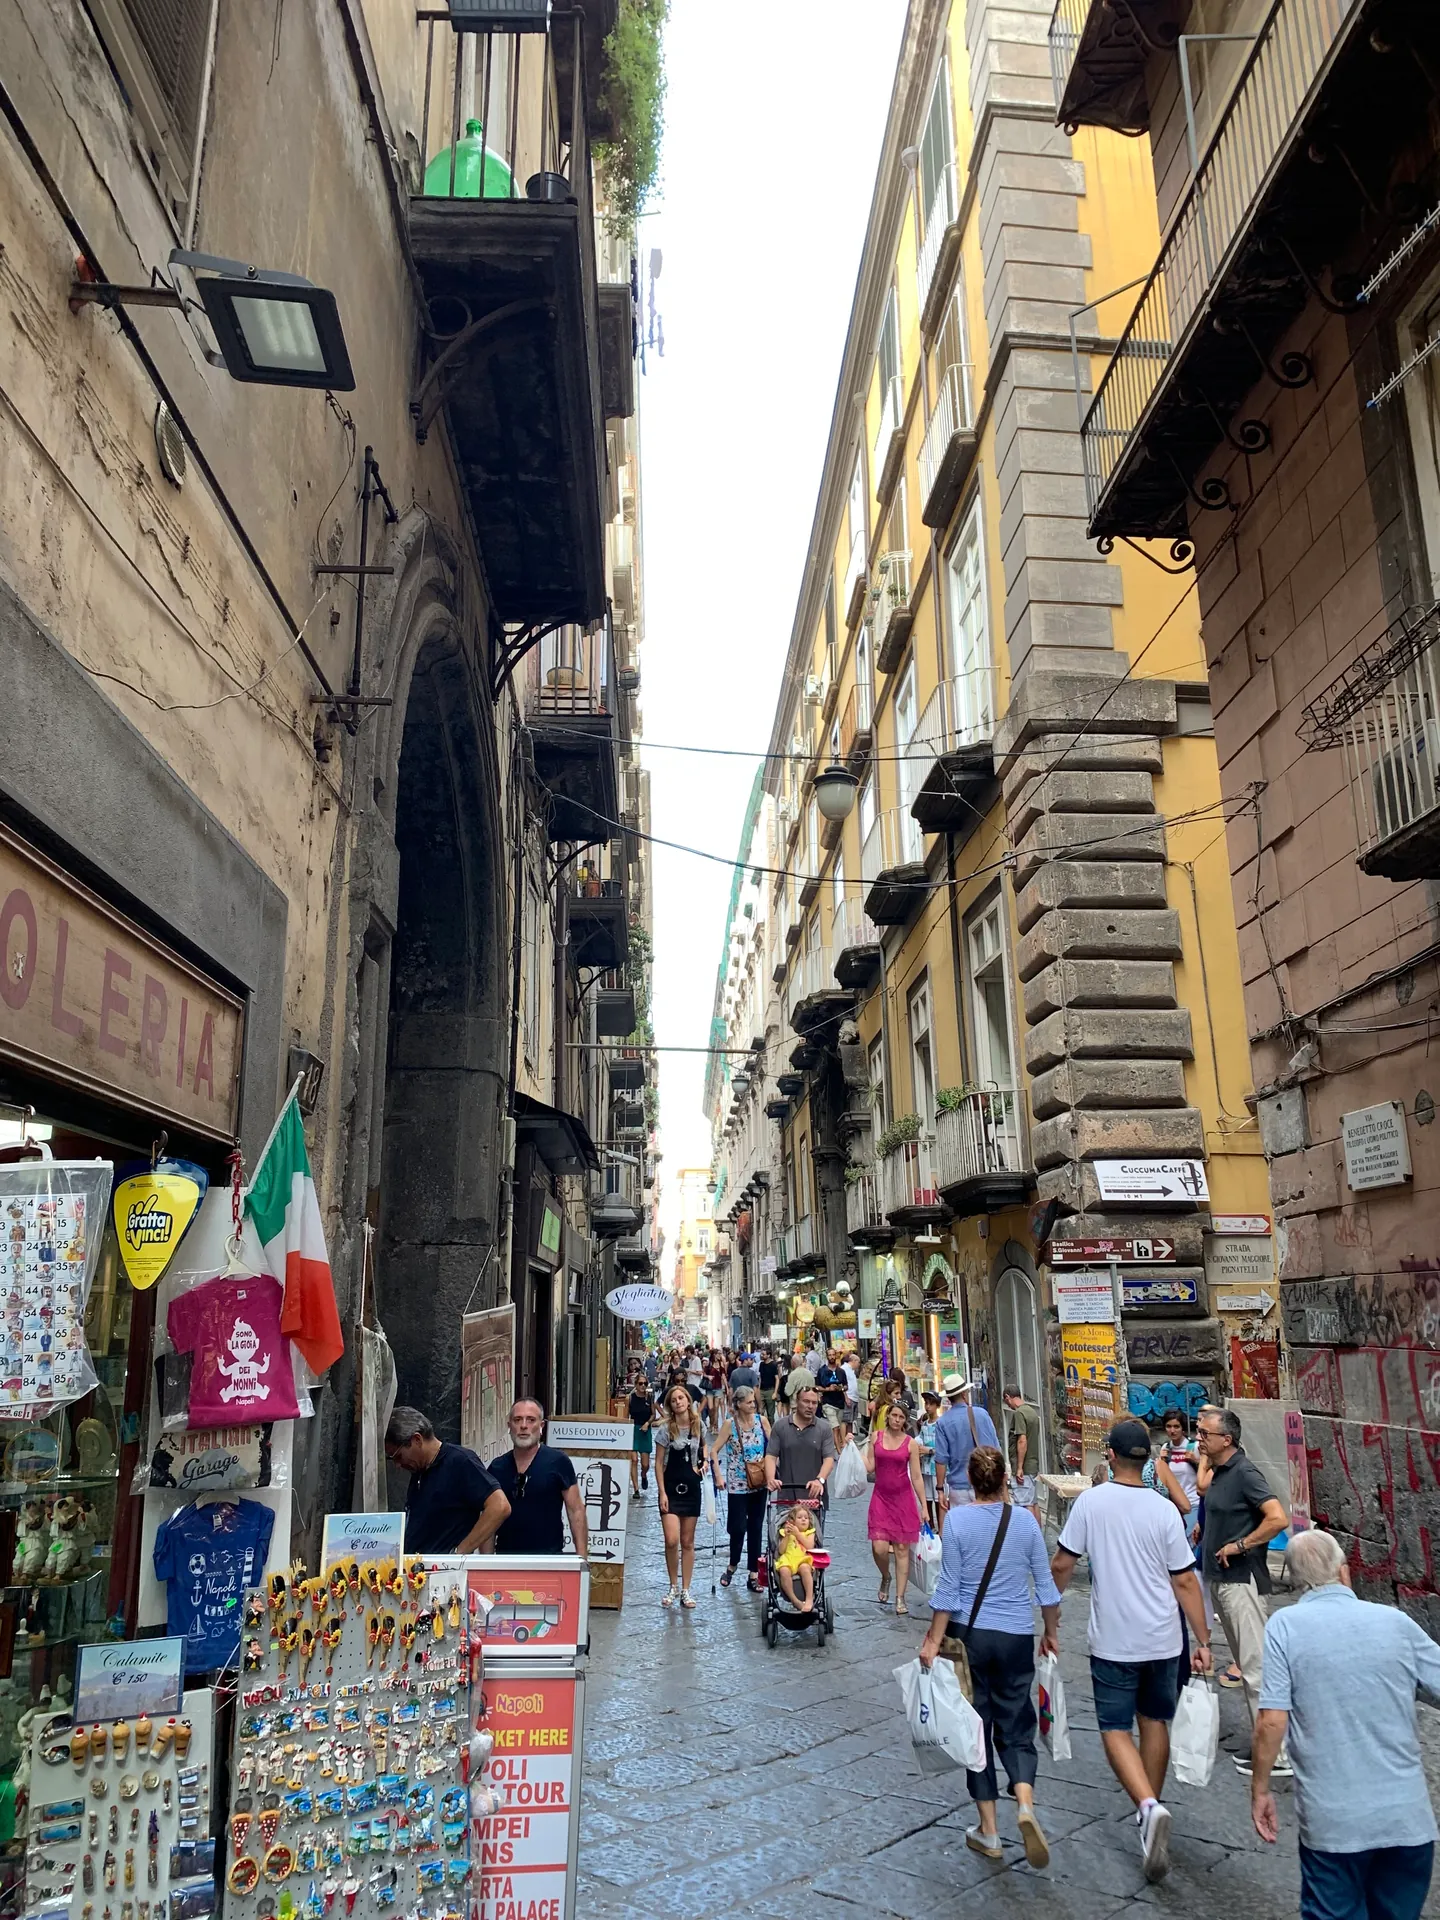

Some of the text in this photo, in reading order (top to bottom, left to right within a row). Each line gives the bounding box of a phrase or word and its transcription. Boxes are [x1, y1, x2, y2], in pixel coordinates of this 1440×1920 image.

[1364, 1114, 1373, 1122] VIA
[1347, 1118, 1394, 1139] BENEDETTO CROCE
[27, 1220, 37, 1229] 14
[57, 1219, 67, 1228] 15
[128, 1212, 167, 1229] Gratta
[26, 1243, 39, 1251] 24
[56, 1240, 69, 1249] 25
[1225, 1244, 1251, 1253] STRADA
[1241, 1254, 1271, 1263] MAGGIORE
[25, 1264, 38, 1273] 34
[55, 1262, 68, 1271] 35
[1221, 1265, 1259, 1274] PIGNATELLI
[25, 1286, 38, 1295] 44
[56, 1284, 69, 1293] 45
[23, 1308, 37, 1317] 54
[54, 1306, 67, 1315] 55
[23, 1331, 37, 1340] 64
[55, 1328, 67, 1338] 65
[235, 1330, 252, 1338] SONO
[231, 1340, 239, 1350] LA
[23, 1354, 34, 1363] 74
[54, 1351, 66, 1361] 75
[22, 1377, 36, 1387] 84
[54, 1374, 66, 1384] 85
[235, 1398, 255, 1406] Napoli
[552, 1427, 626, 1438] MUSEODIVINO
[178, 1454, 240, 1490] Garage
[341, 1518, 392, 1536] Calamite
[205, 1575, 238, 1600] Napoli
[100, 1648, 168, 1668] Calamite
[496, 1693, 544, 1716] Napoli
[491, 1728, 568, 1747] KET HERE
[503, 1781, 564, 1805] TOUR
